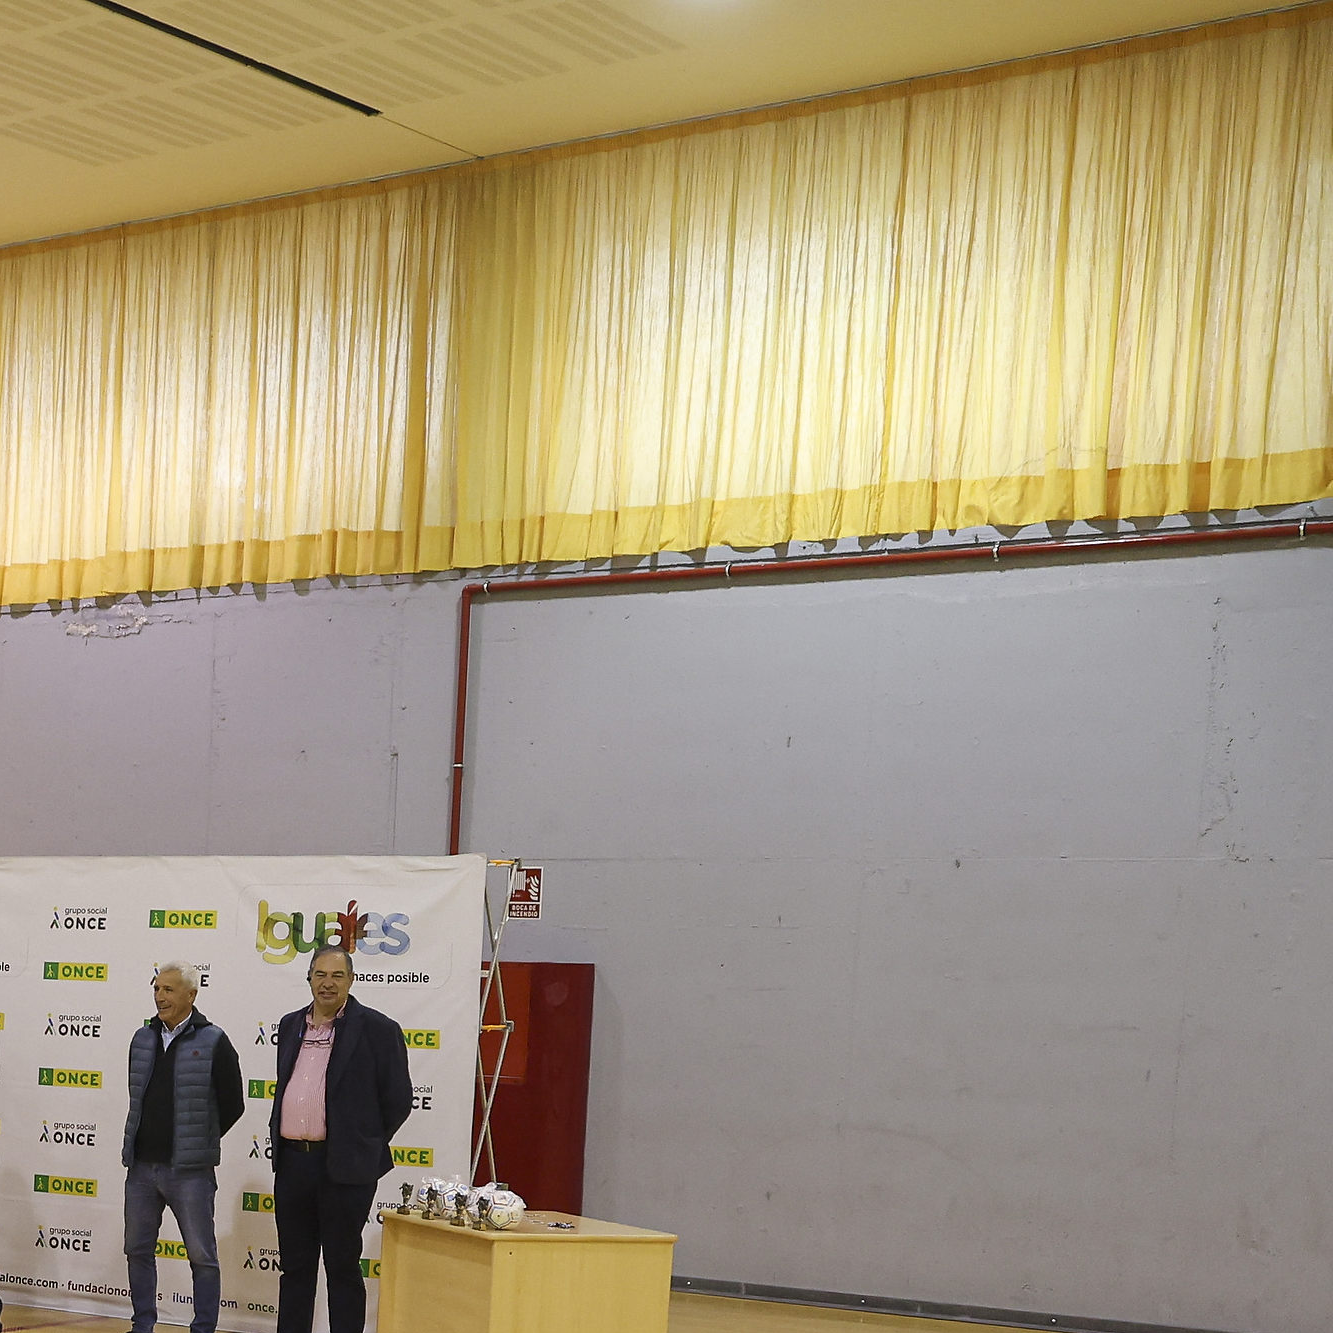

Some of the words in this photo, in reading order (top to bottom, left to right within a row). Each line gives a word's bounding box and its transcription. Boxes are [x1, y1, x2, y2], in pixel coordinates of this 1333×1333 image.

[87, 907, 108, 915] social
[64, 917, 107, 930] ONCE
[168, 913, 214, 926] ONCE
[256, 900, 410, 965] Iguales
[62, 965, 105, 978] ONCE
[388, 973, 430, 984] posible
[59, 1014, 80, 1022] grupo
[58, 1024, 101, 1037] ONCE
[404, 1032, 436, 1046] NCE
[56, 1072, 99, 1086] ONCE
[414, 1085, 433, 1093] ocial
[412, 1097, 432, 1110] CE
[54, 1122, 75, 1130] grupo
[76, 1123, 97, 1131] social
[53, 1132, 96, 1146] ONCE
[394, 1149, 429, 1164] NCE
[52, 1179, 94, 1194] ONCE
[377, 1201, 401, 1210] grupo
[49, 1227, 71, 1236] grupo
[71, 1228, 92, 1237] social
[49, 1237, 91, 1252] ONCE
[155, 1242, 187, 1257] ONC
[259, 1258, 282, 1272] ON
